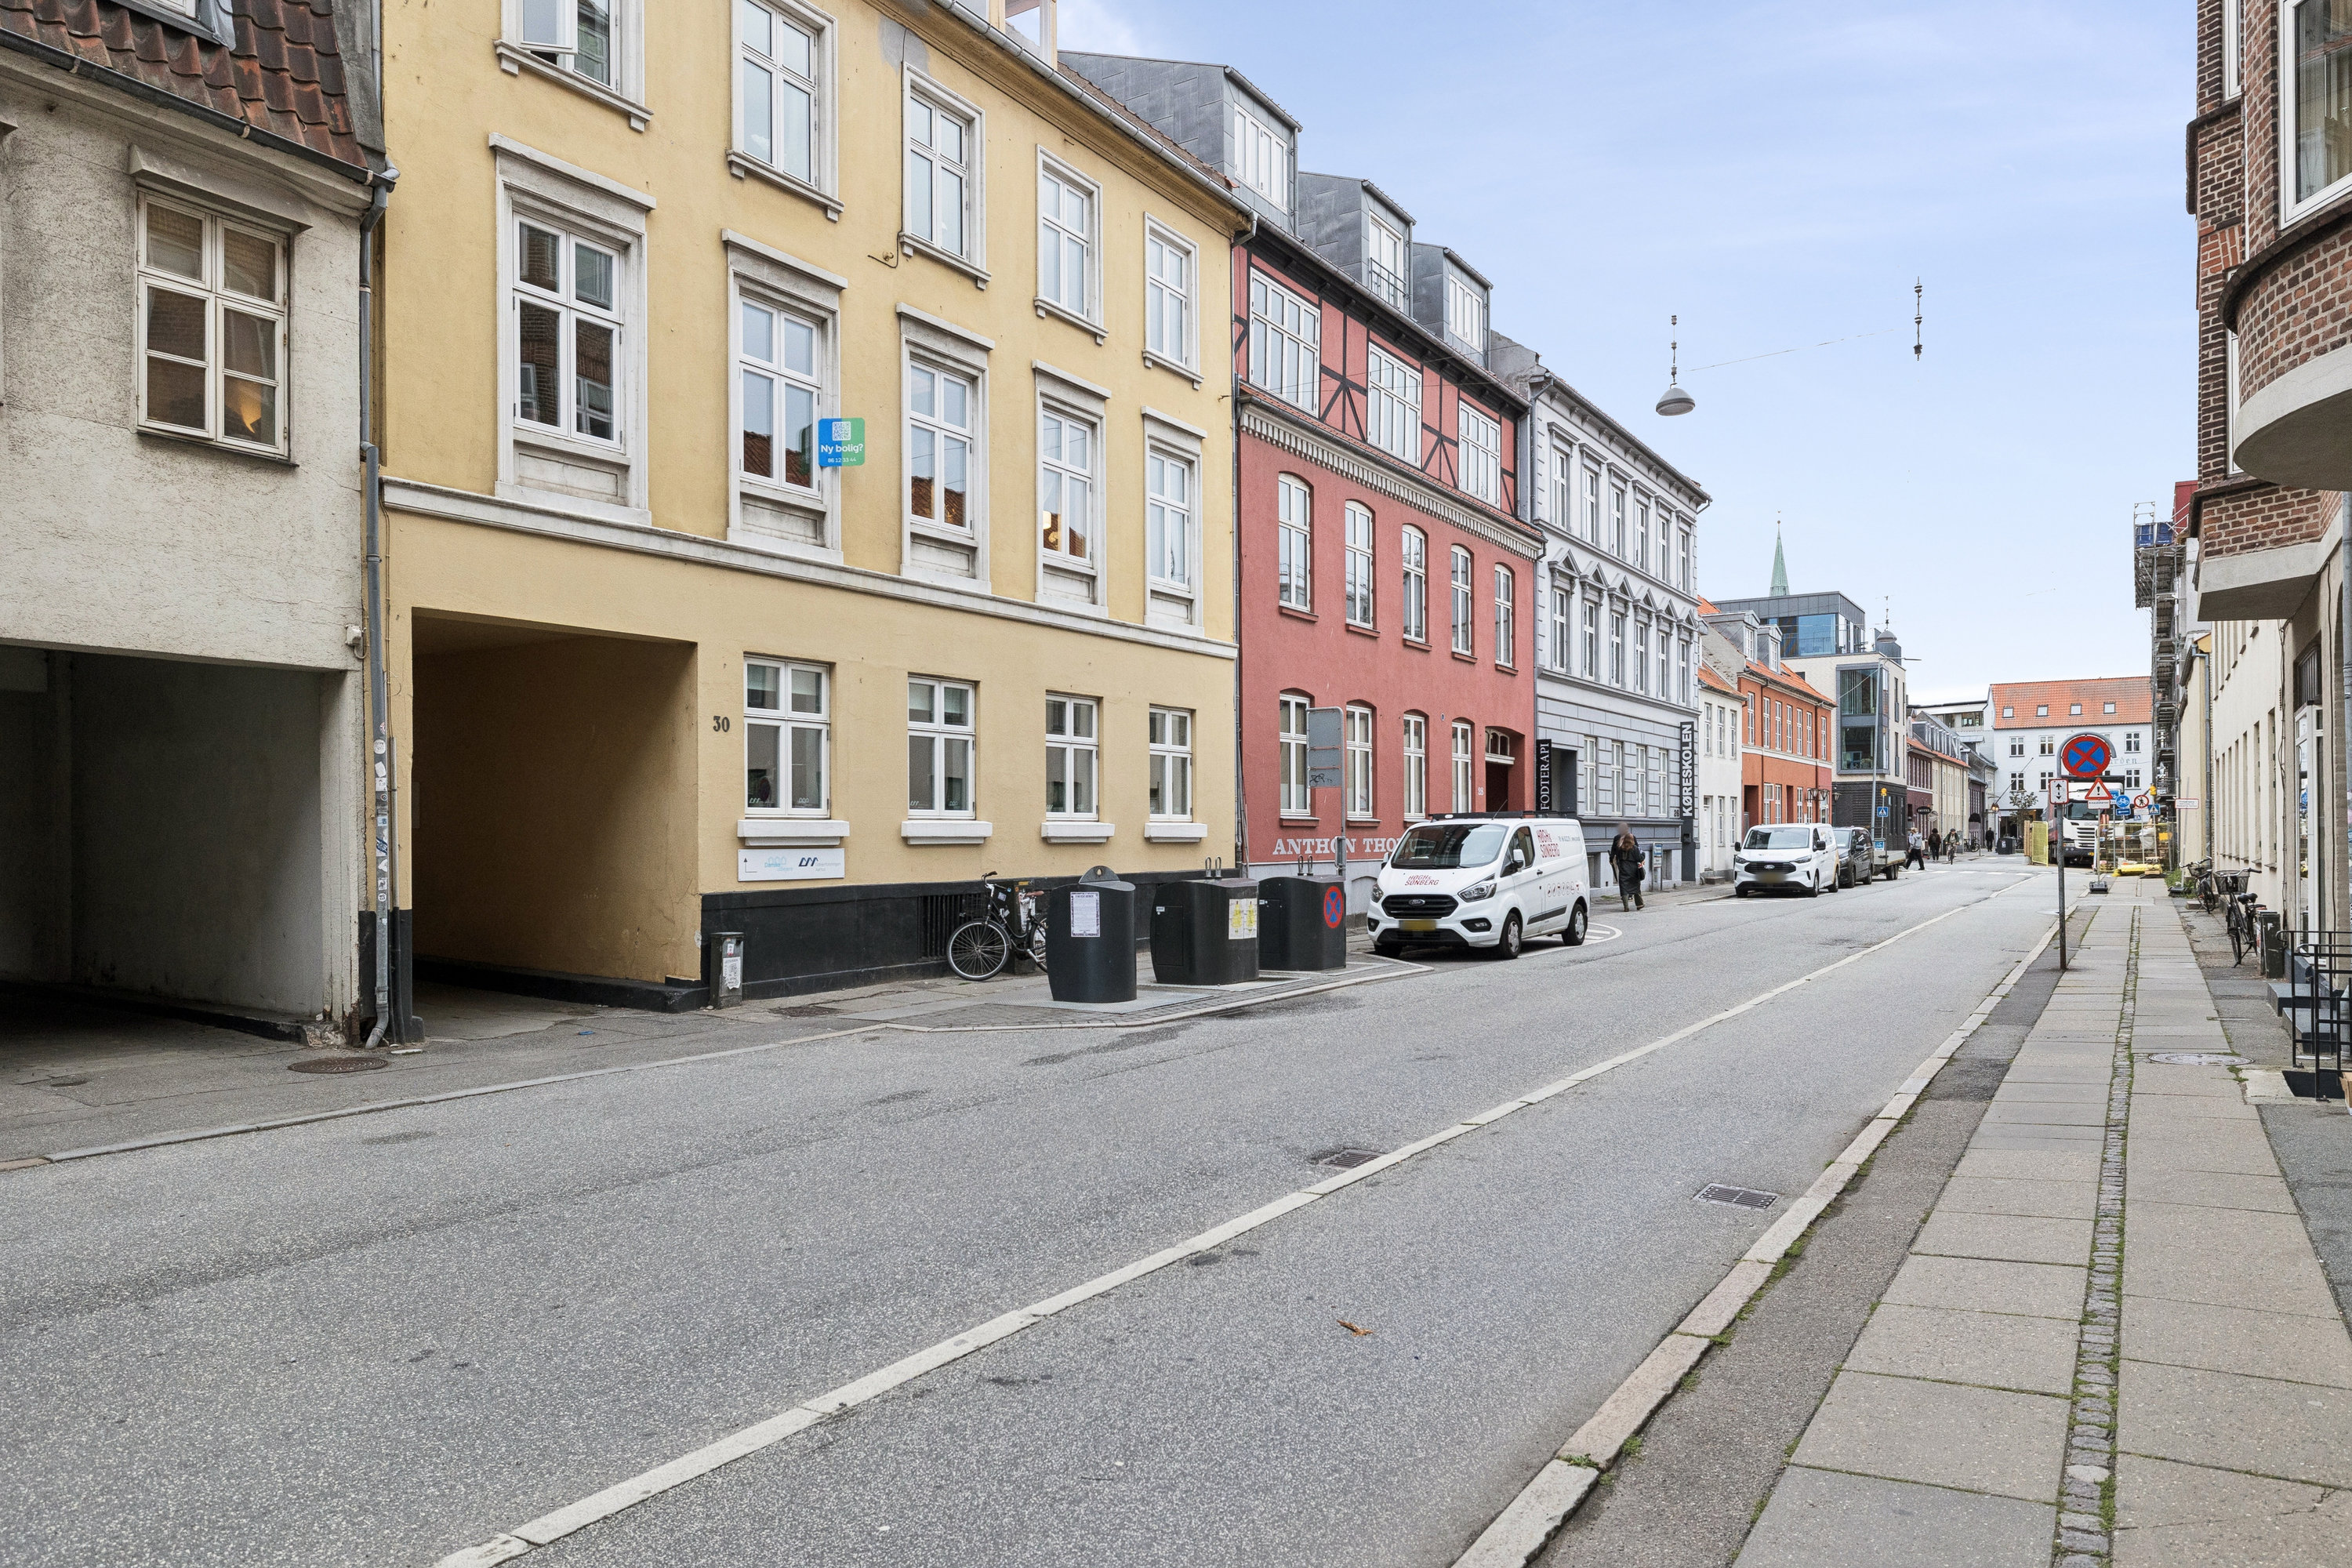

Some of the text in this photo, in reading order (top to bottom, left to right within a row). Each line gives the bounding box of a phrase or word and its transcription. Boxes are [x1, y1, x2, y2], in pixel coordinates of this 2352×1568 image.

[821, 443, 863, 454] Ny bolig?
[713, 715, 730, 732] 30
[1541, 742, 1550, 810] FODTERAPI
[1682, 724, 1693, 817] KØRESKOLEN
